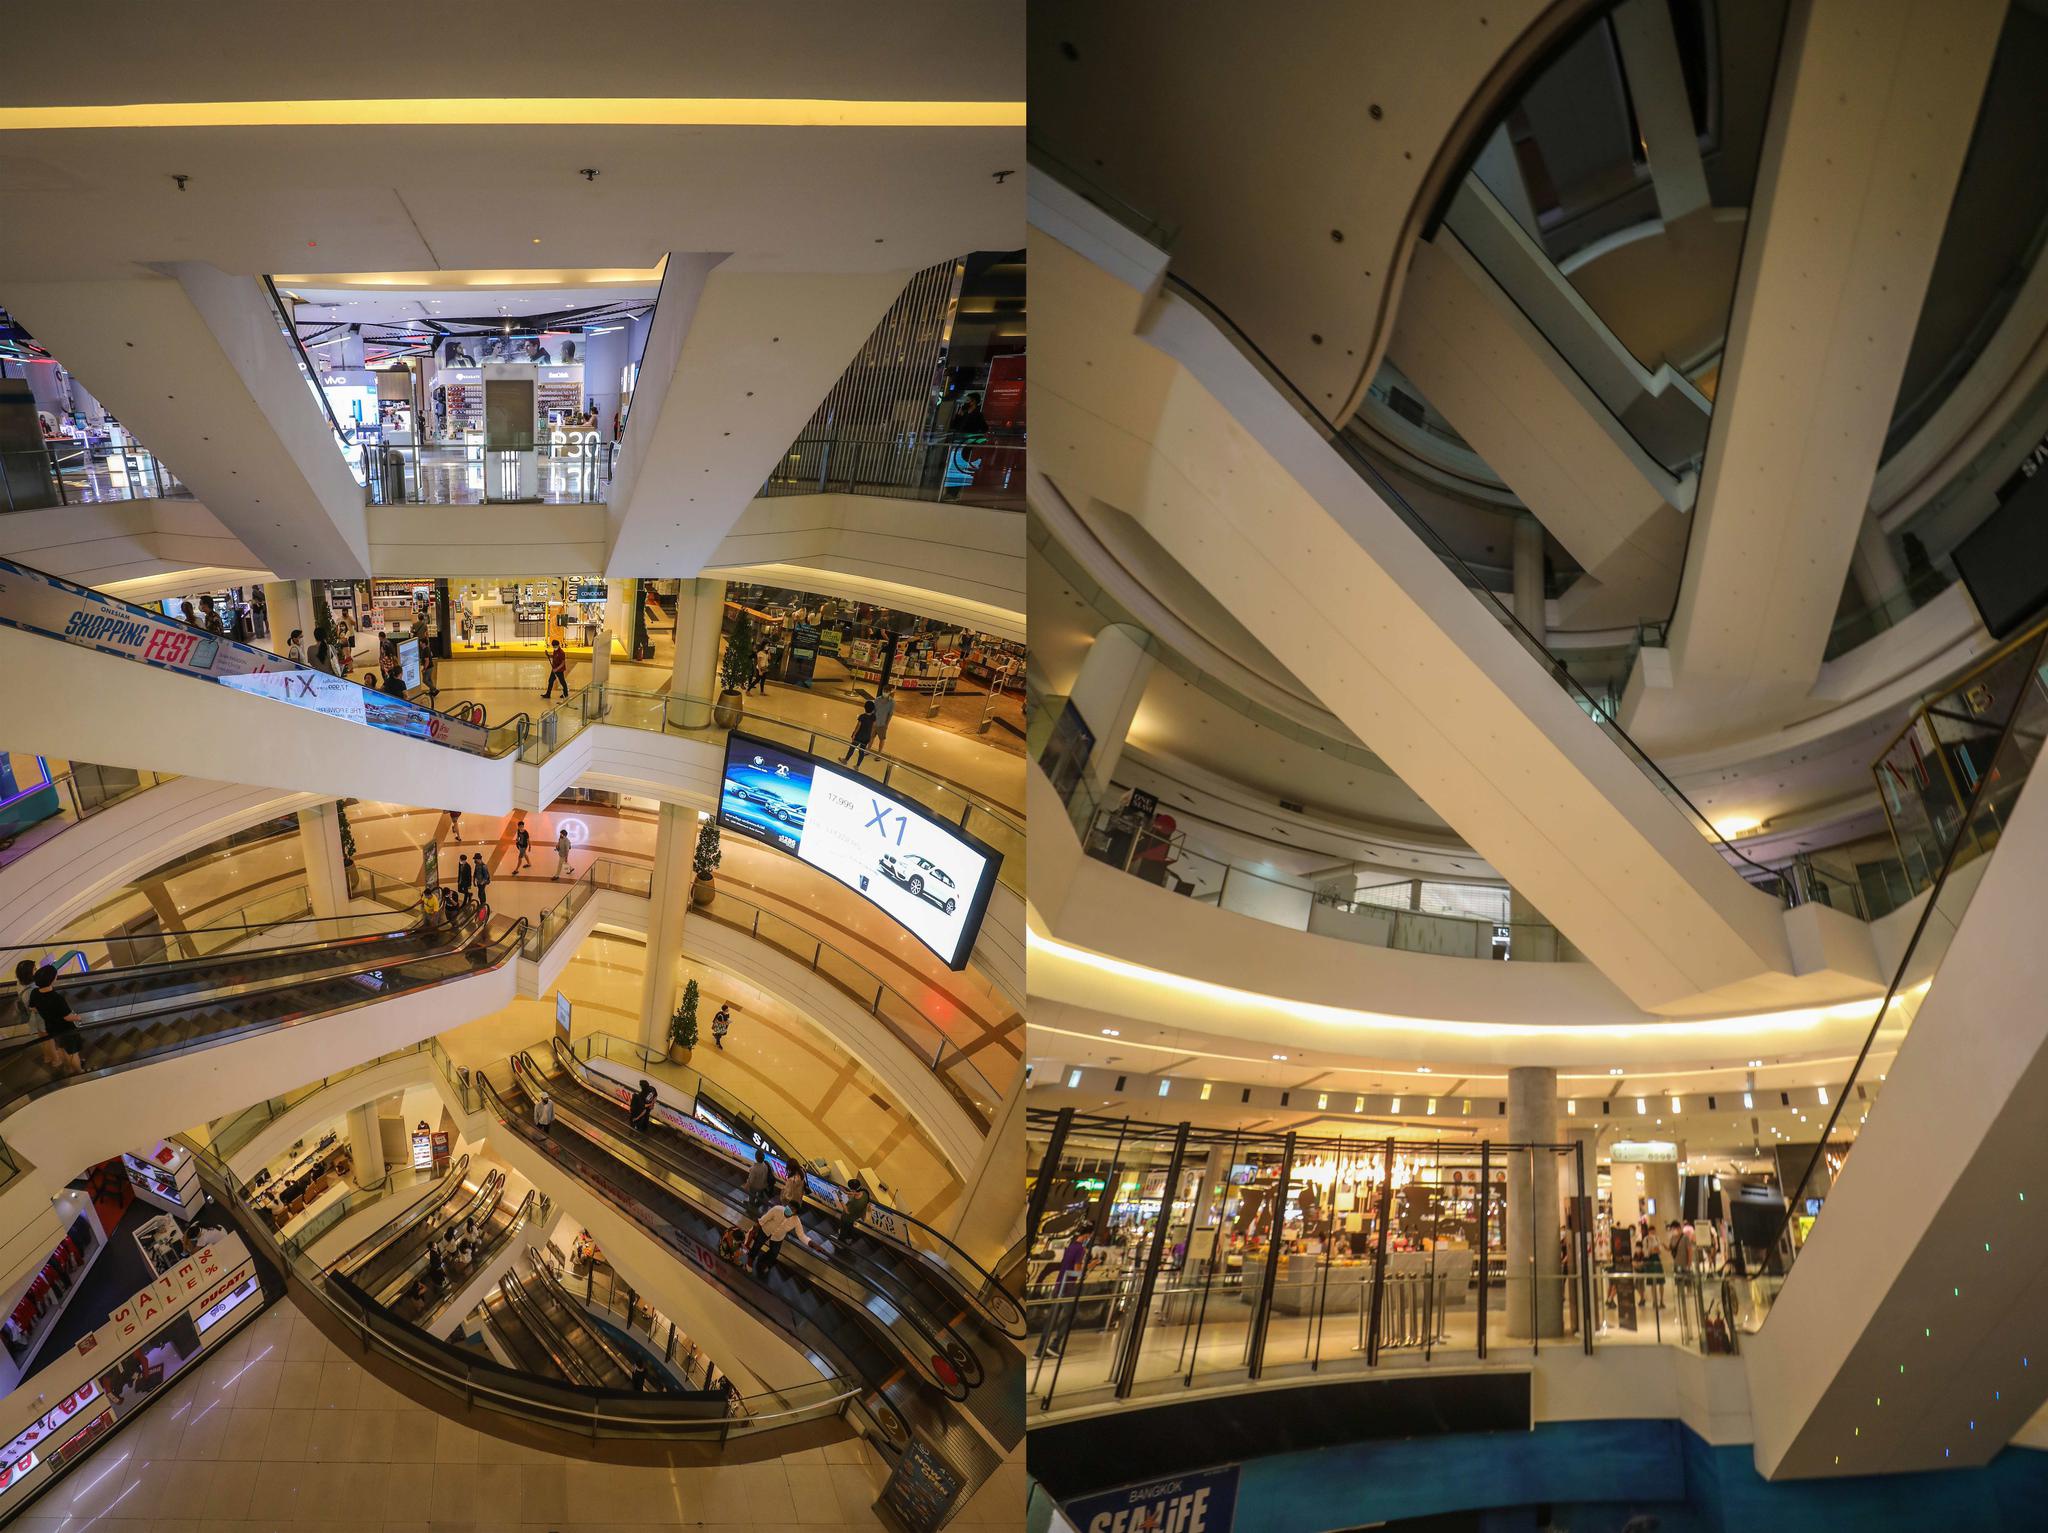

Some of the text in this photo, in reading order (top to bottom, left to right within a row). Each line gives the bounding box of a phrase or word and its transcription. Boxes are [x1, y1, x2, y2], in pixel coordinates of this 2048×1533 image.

[101, 606, 130, 620] ONESIAM
[64, 610, 150, 647] SHOPPING
[143, 628, 198, 664] FEST
[864, 798, 908, 847] X1
[200, 1269, 245, 1310] DUCATI
[914, 1454, 941, 1481] NOW
[921, 1468, 948, 1495] OPEN
[1128, 1480, 1184, 1503] BANGKOK
